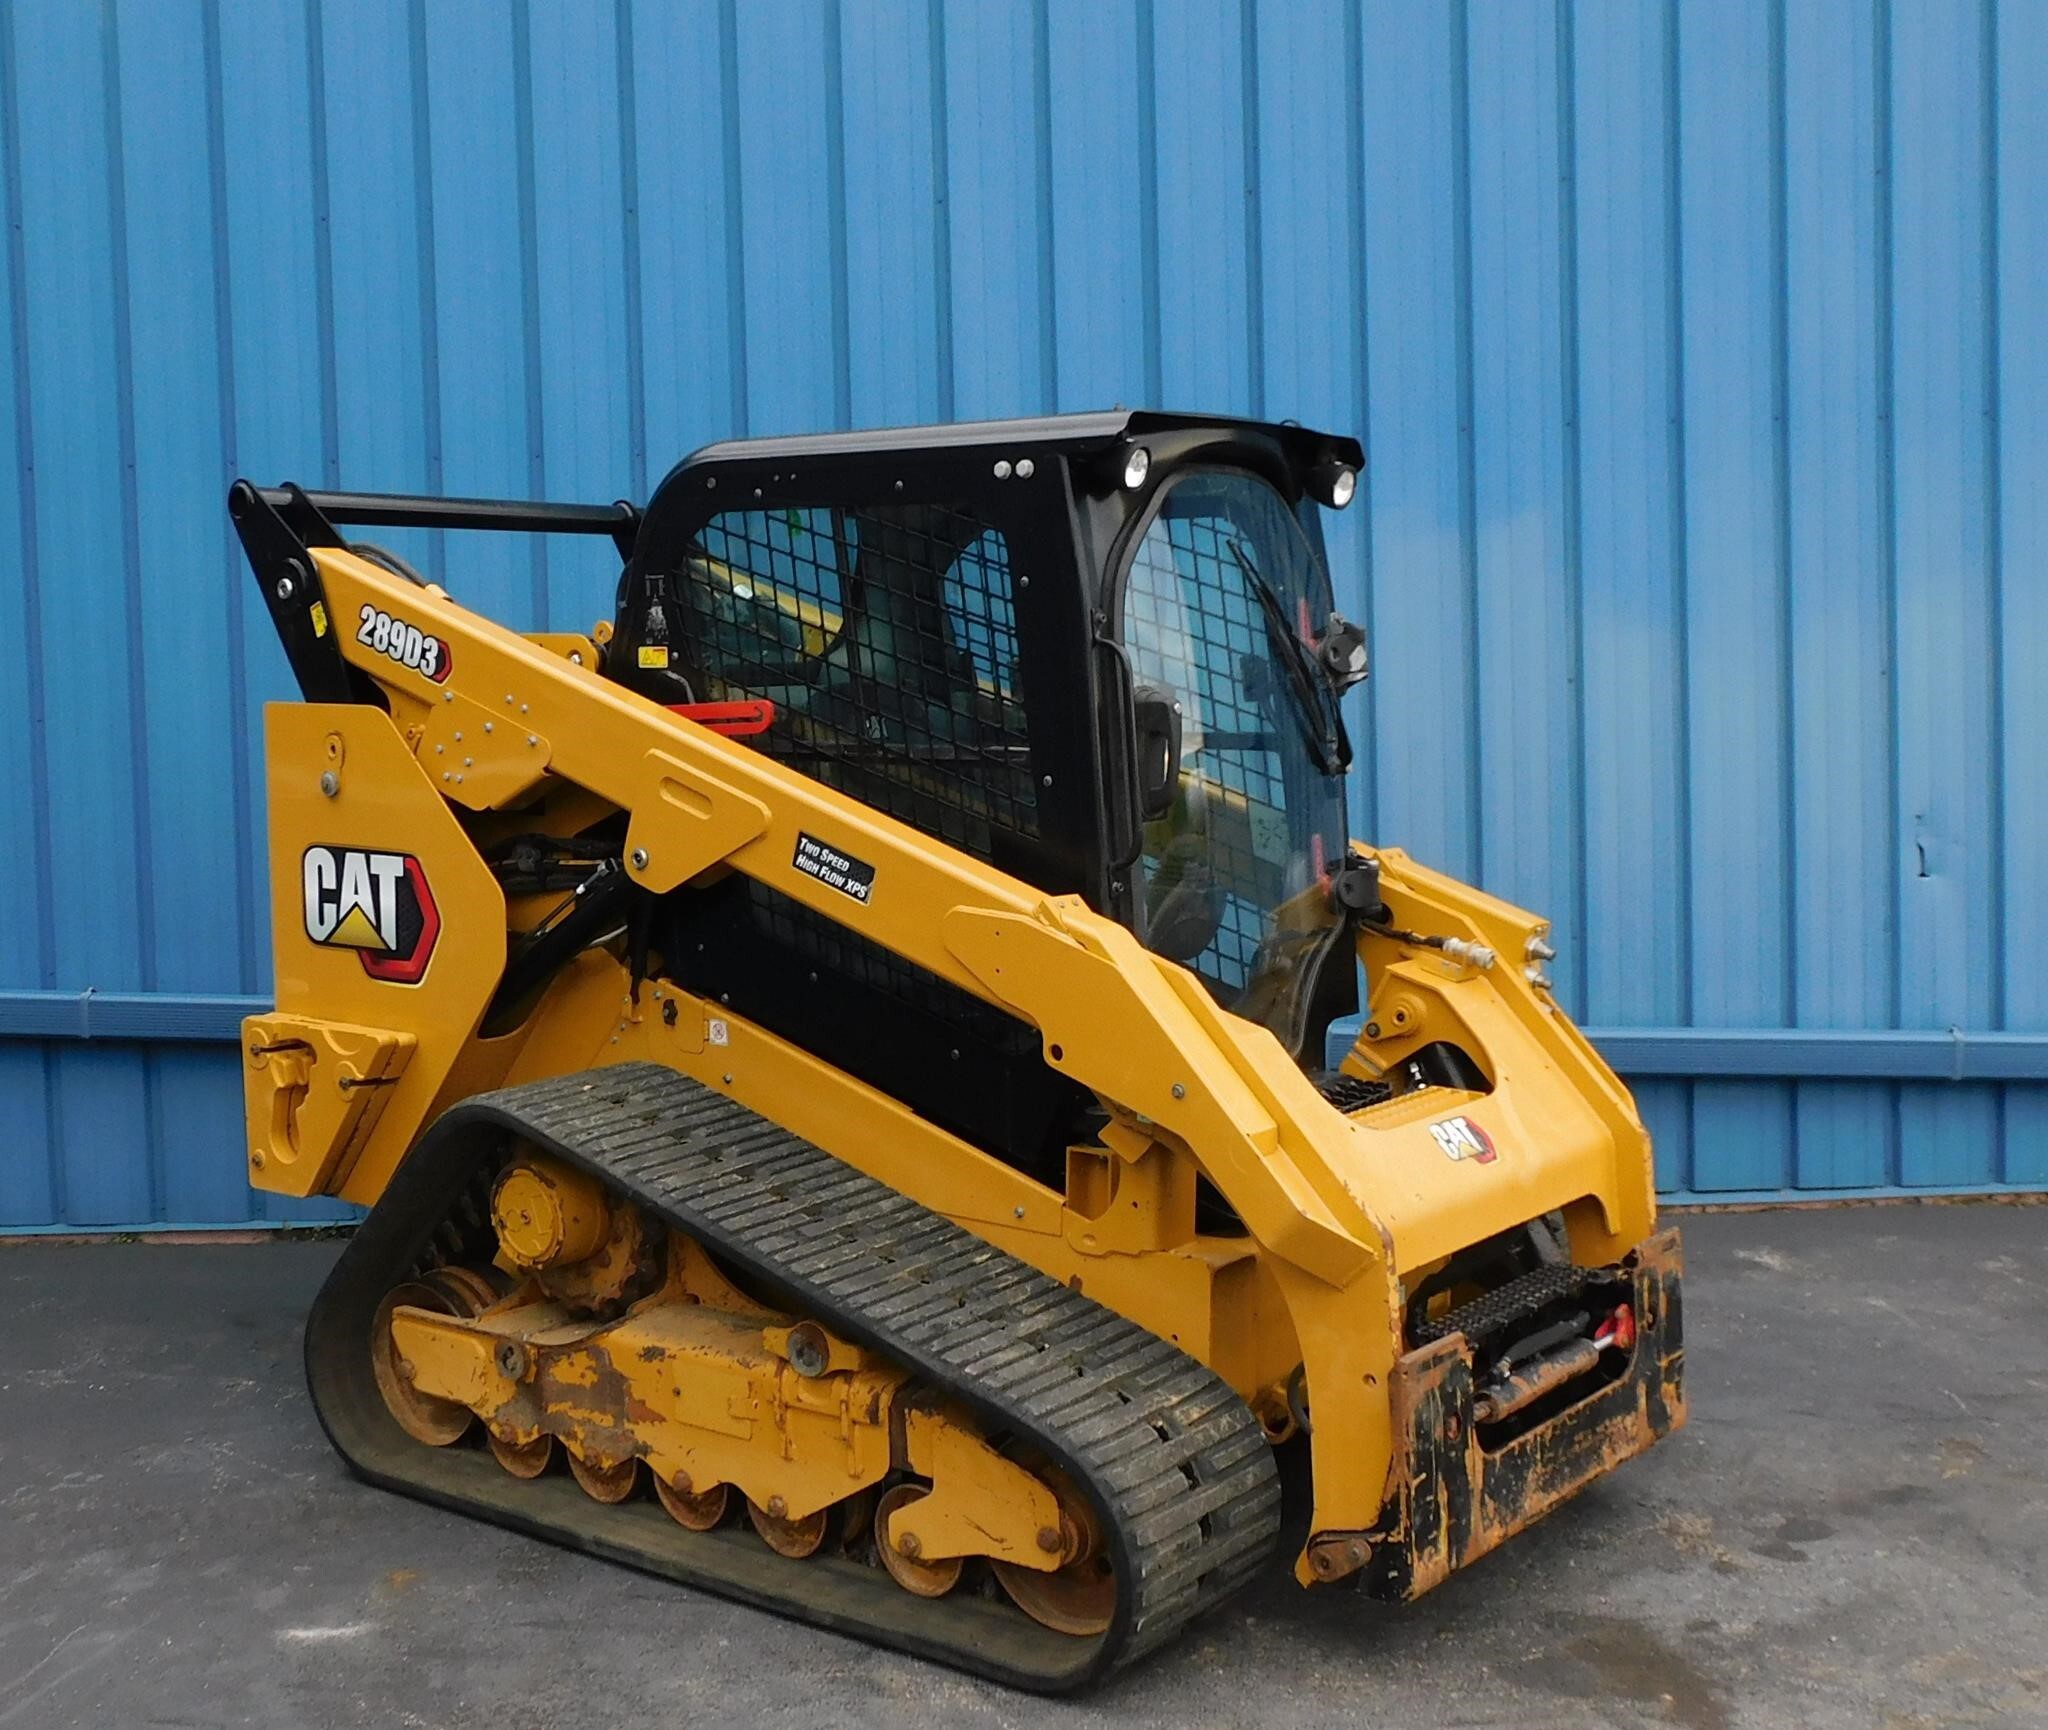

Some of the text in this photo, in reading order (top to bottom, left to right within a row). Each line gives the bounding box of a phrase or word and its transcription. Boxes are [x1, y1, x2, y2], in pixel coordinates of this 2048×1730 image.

[357, 604, 439, 677] 289D3
[304, 847, 404, 951] CAT
[844, 878, 868, 899] XPS
[1428, 1117, 1485, 1161] CAT
